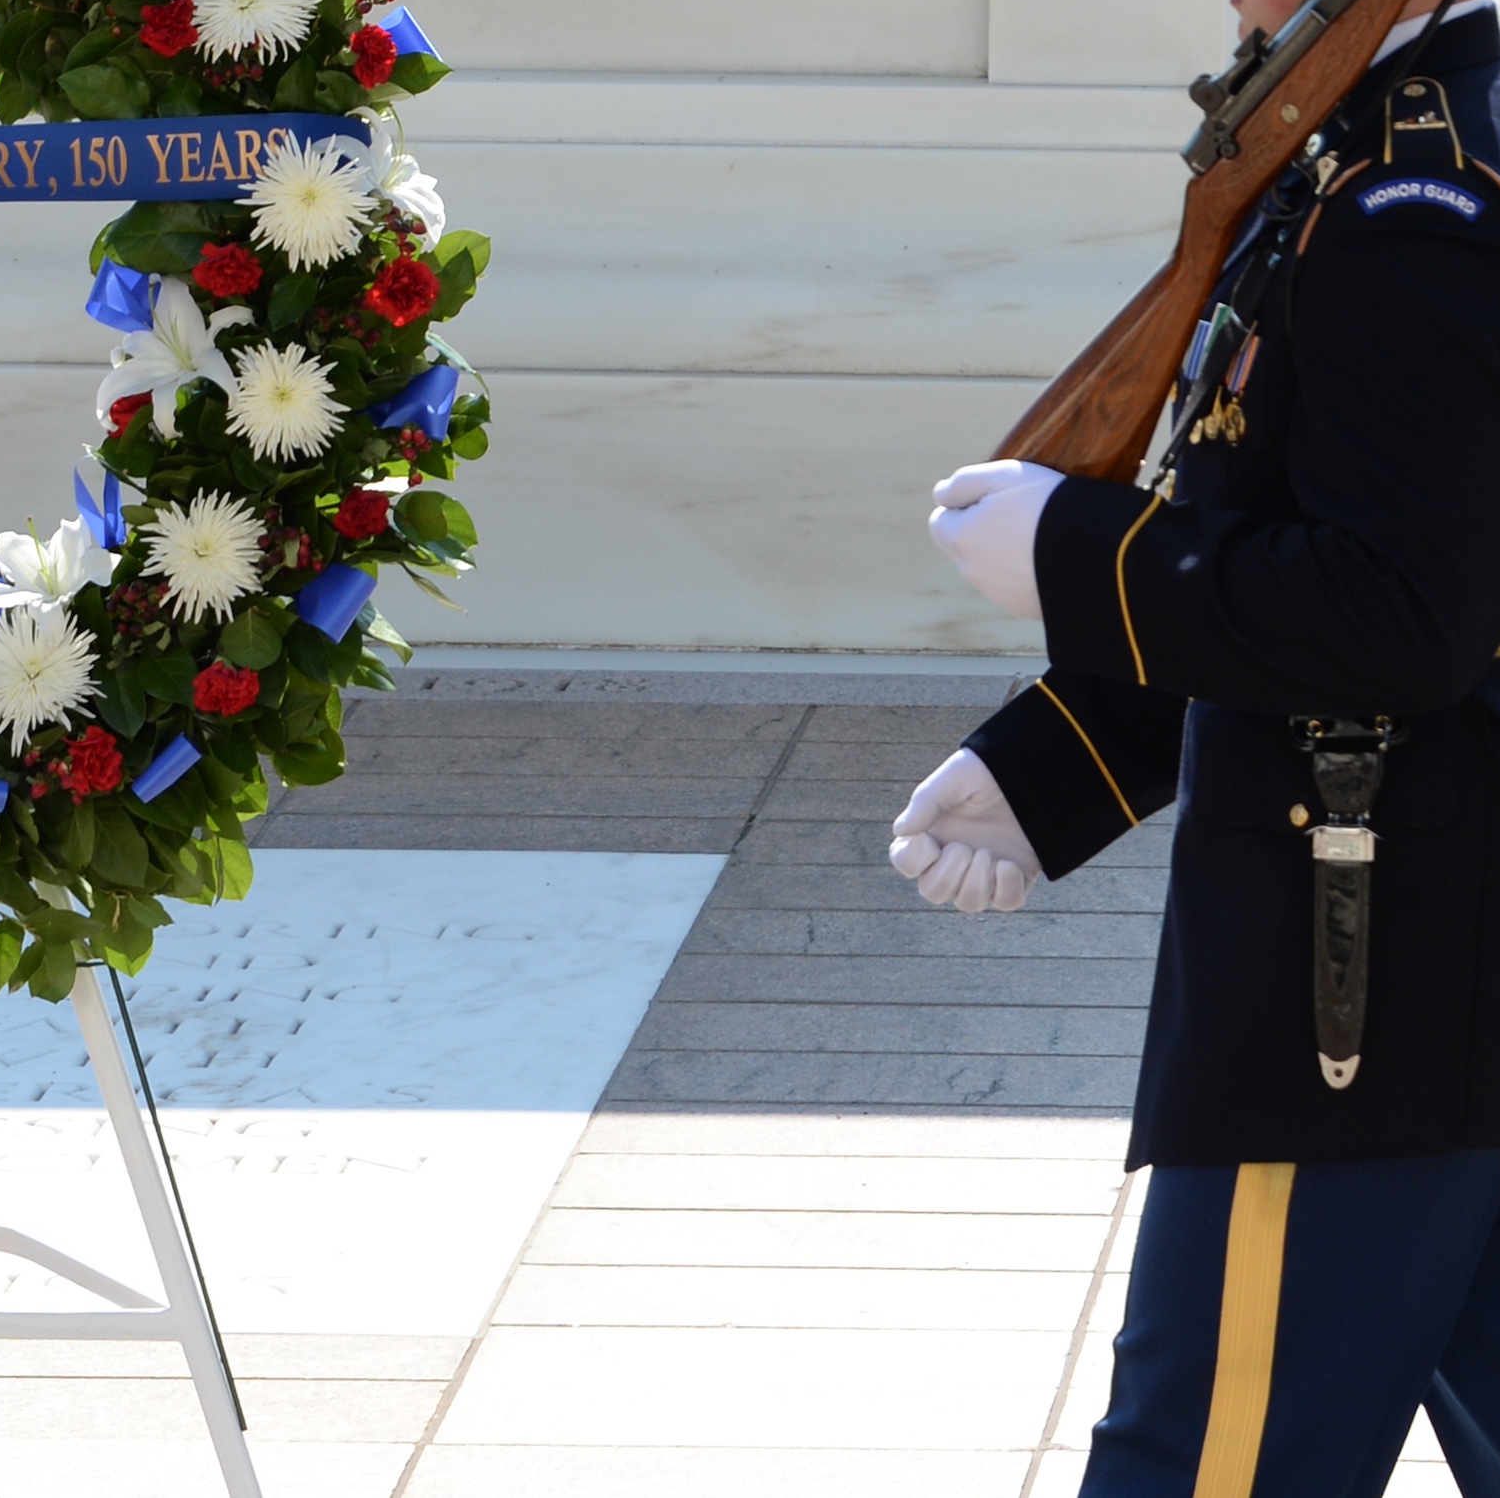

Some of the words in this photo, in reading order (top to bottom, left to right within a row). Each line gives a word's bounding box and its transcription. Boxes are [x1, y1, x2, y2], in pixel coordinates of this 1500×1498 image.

[69, 135, 128, 188] 150
[145, 128, 288, 183] YEARS
[1363, 183, 1422, 208] HONOR
[1423, 184, 1477, 214] GUARD
